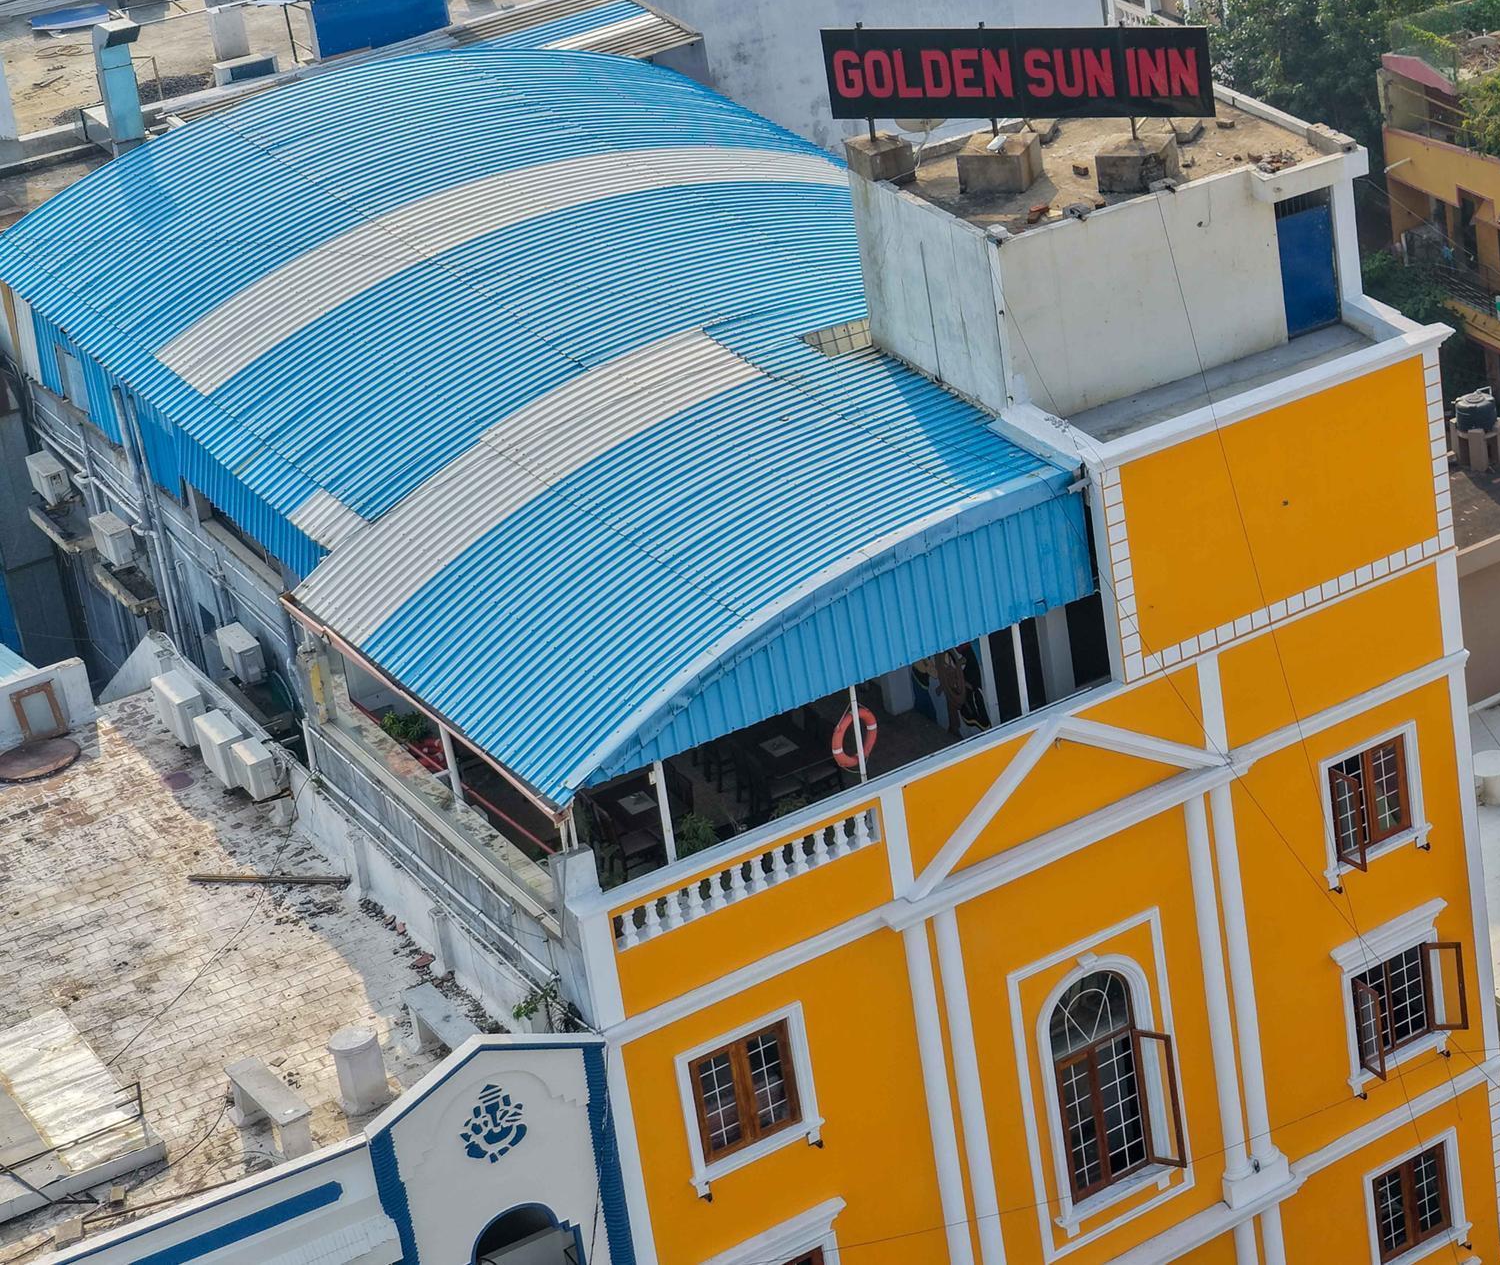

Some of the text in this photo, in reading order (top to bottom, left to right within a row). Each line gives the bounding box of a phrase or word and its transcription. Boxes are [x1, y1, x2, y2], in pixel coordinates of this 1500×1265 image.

[832, 46, 1200, 99] GOLDEN SUN INN
